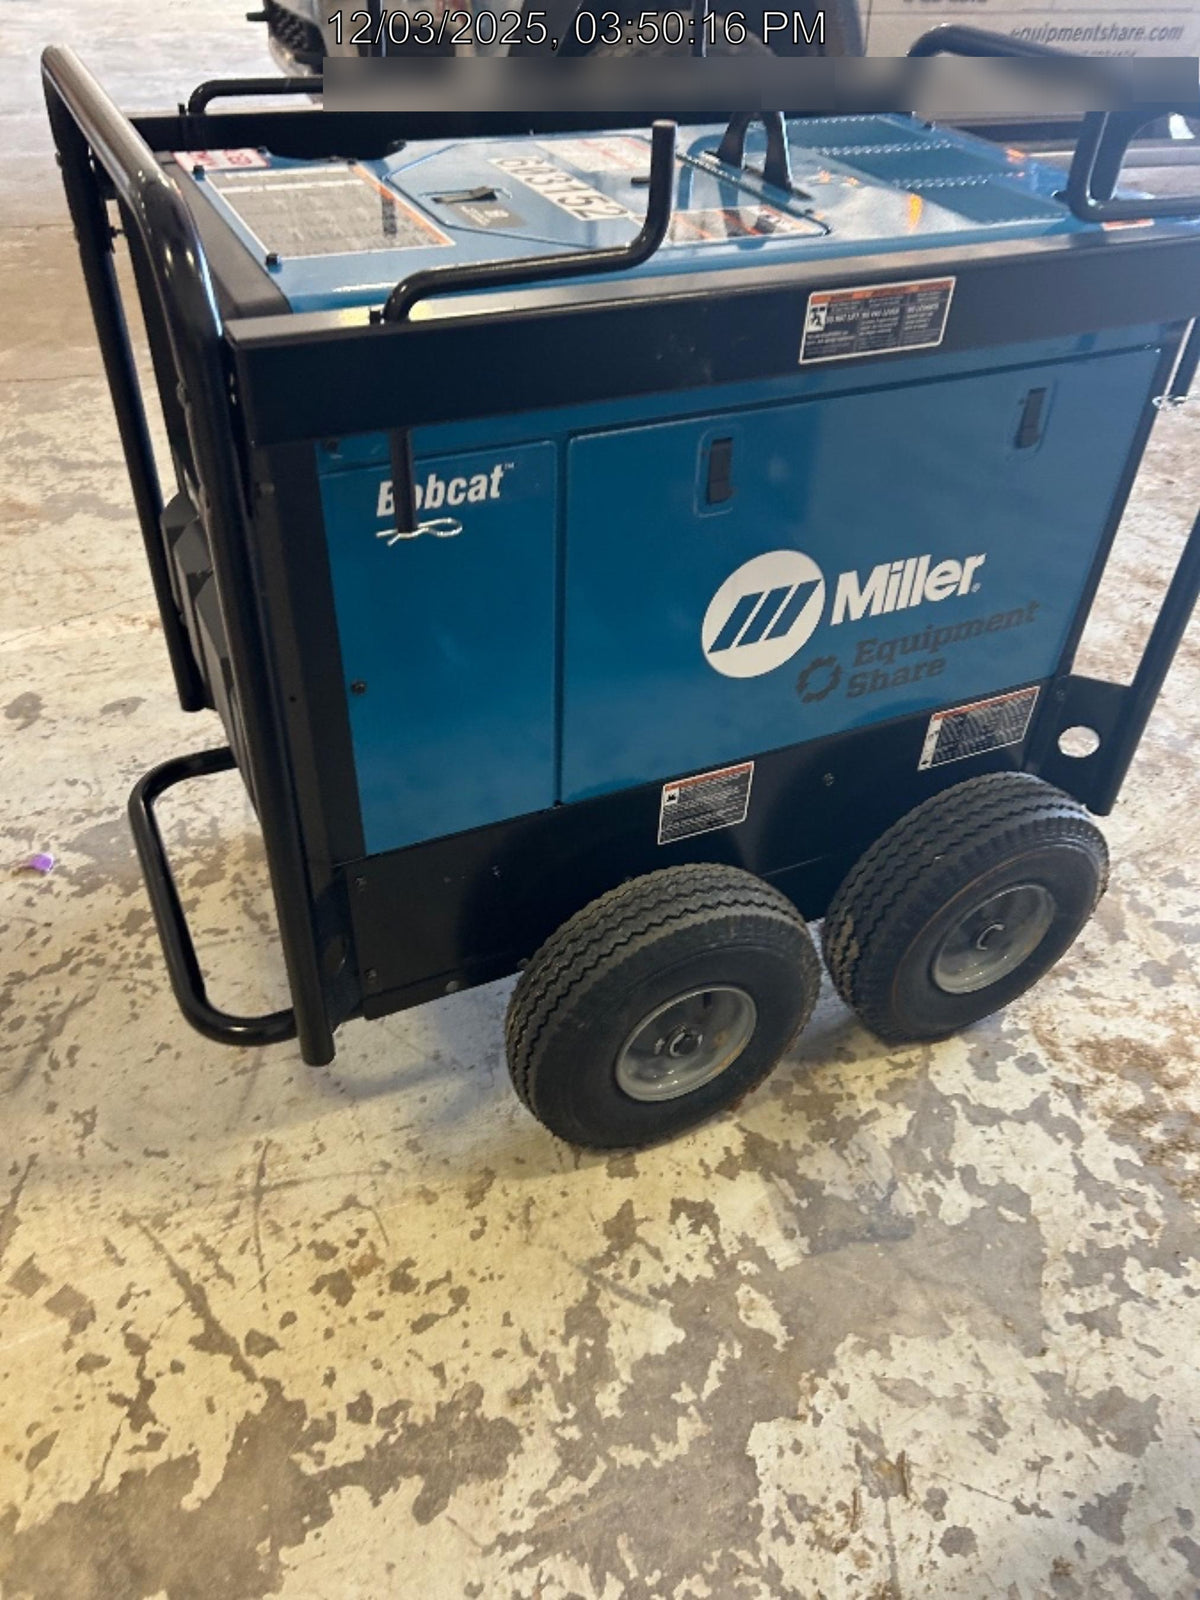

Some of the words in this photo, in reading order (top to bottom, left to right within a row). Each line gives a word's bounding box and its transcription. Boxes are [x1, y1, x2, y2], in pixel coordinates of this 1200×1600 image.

[830, 553, 987, 626] Miller
[853, 600, 1040, 667] Equipment
[845, 647, 946, 698] Share
